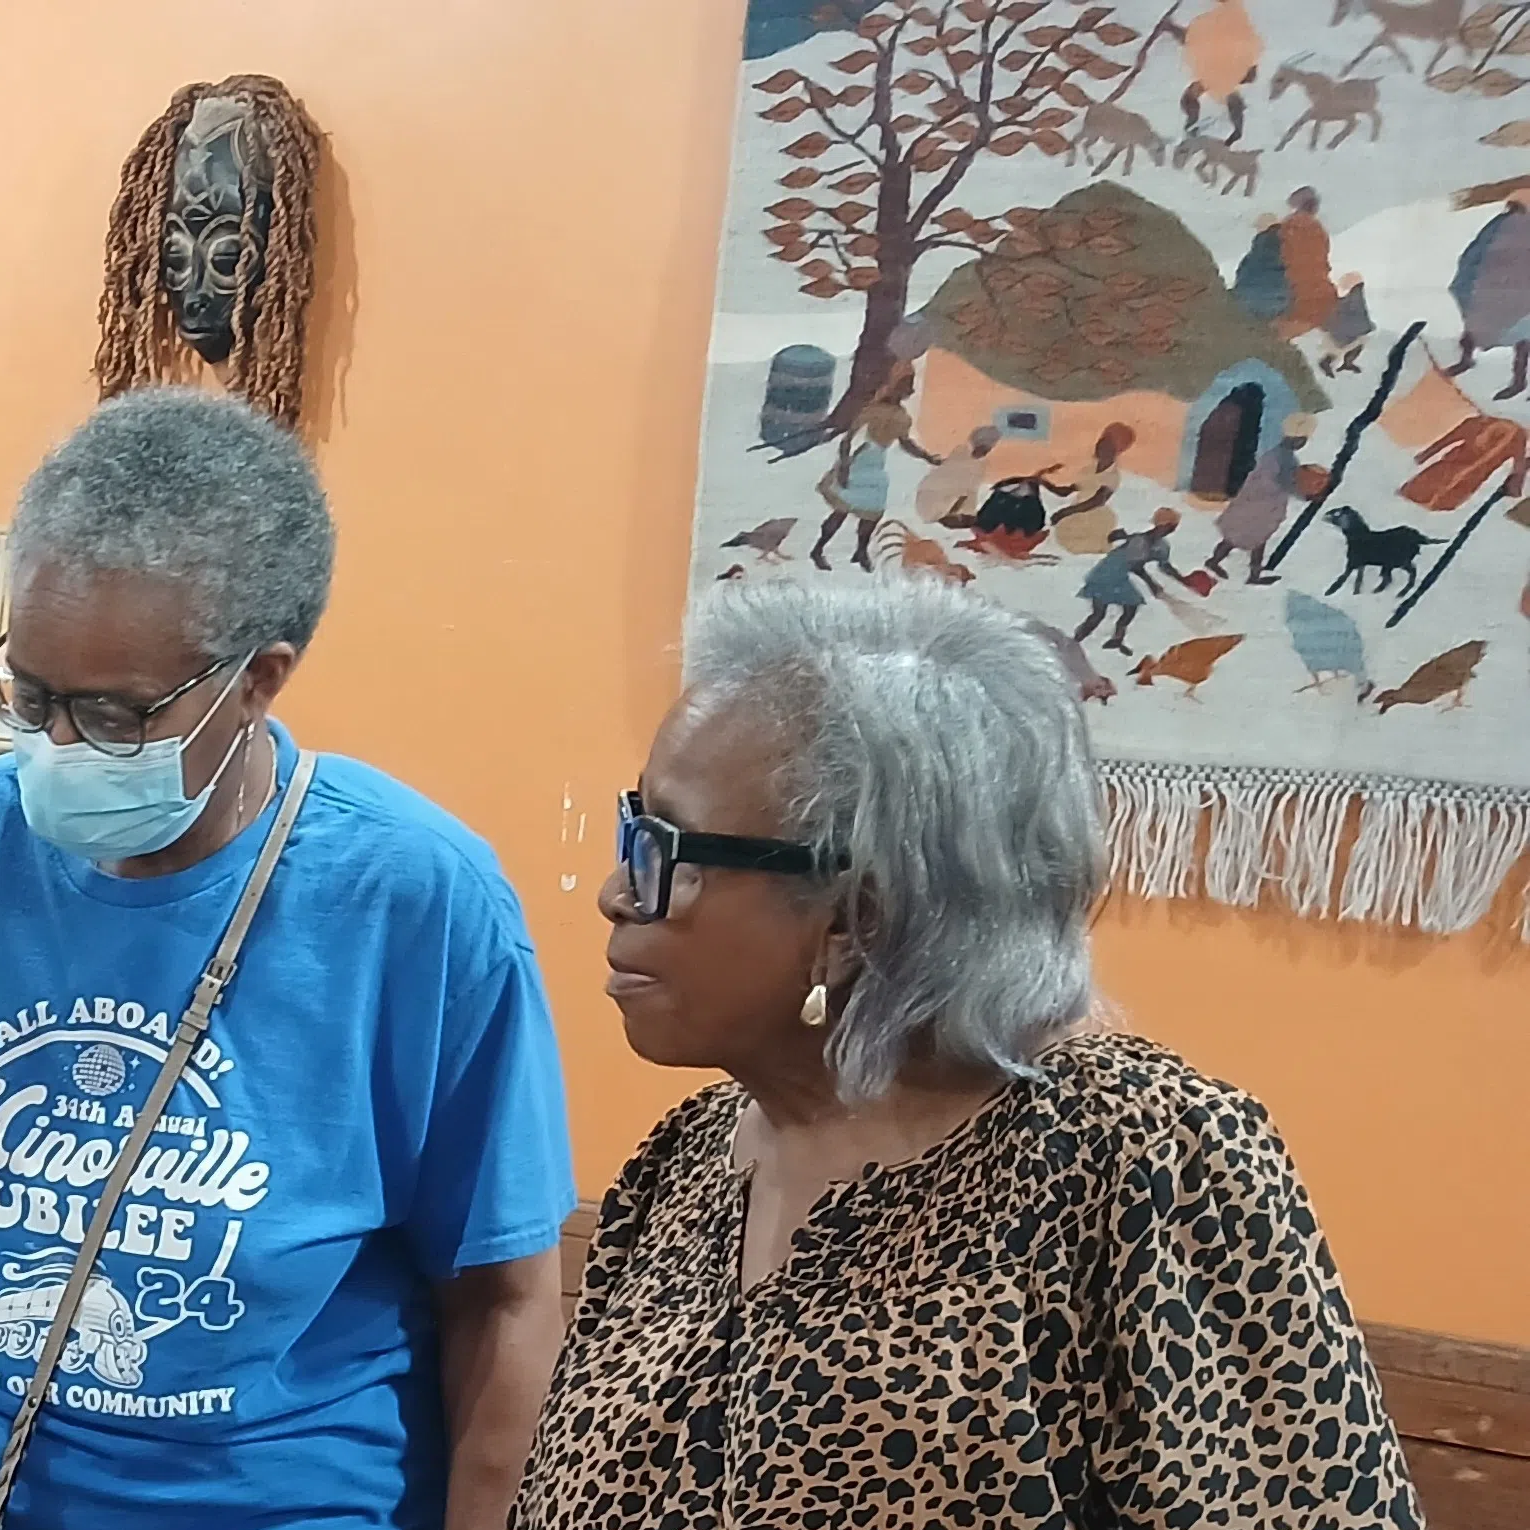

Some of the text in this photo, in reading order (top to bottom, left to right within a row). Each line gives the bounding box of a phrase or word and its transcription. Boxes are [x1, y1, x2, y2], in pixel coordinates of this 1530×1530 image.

[67, 996, 235, 1081] ABOAD!
[52, 1095, 208, 1138] 34th Anual
[135, 1267, 246, 1331] 24
[65, 1384, 236, 1419] COMMUNITY
